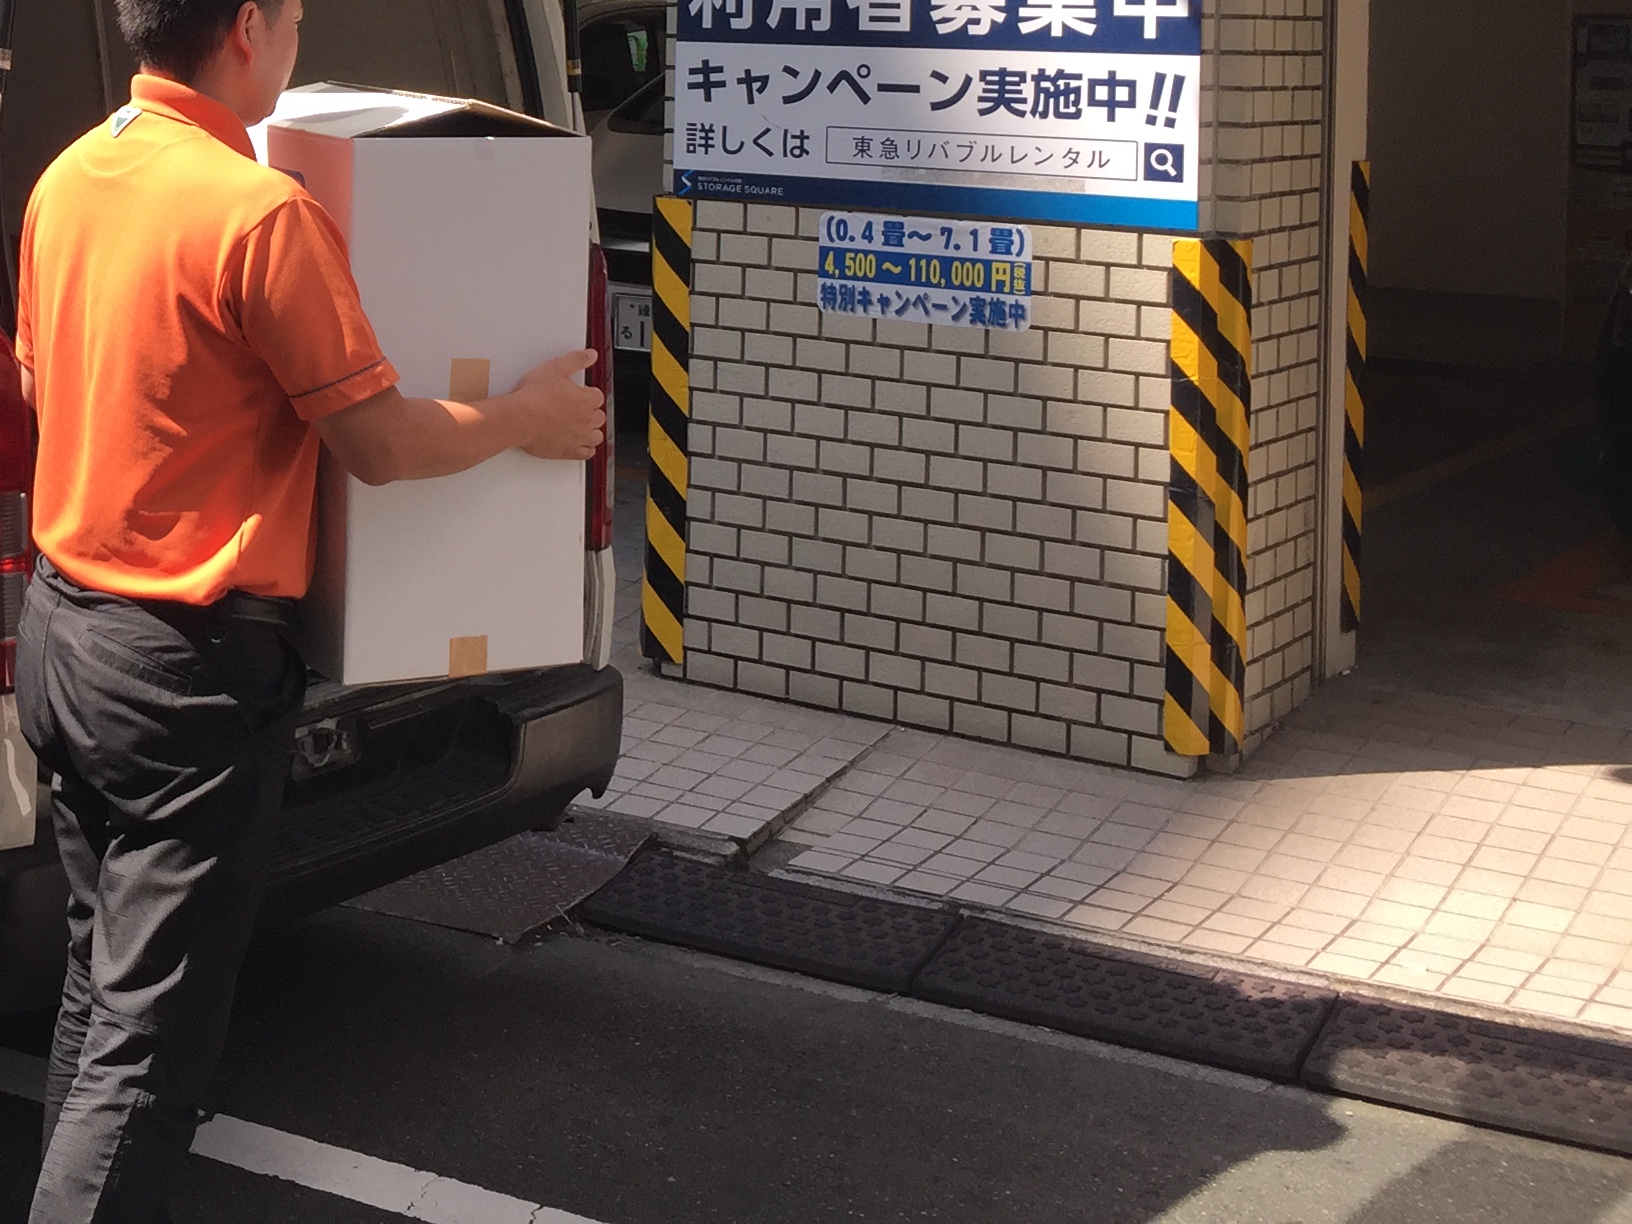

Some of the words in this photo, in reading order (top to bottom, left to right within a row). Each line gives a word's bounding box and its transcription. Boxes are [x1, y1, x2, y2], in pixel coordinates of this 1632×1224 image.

[685, 59, 1186, 129] キャンペーン実施中!!
[685, 123, 810, 159] 詳しくは
[853, 135, 1112, 171] 東急リバブルレンタル
[697, 182, 743, 194] STORAGE
[744, 185, 784, 196] SQUARE
[820, 281, 1026, 329] 特別キャンペーン実施中
